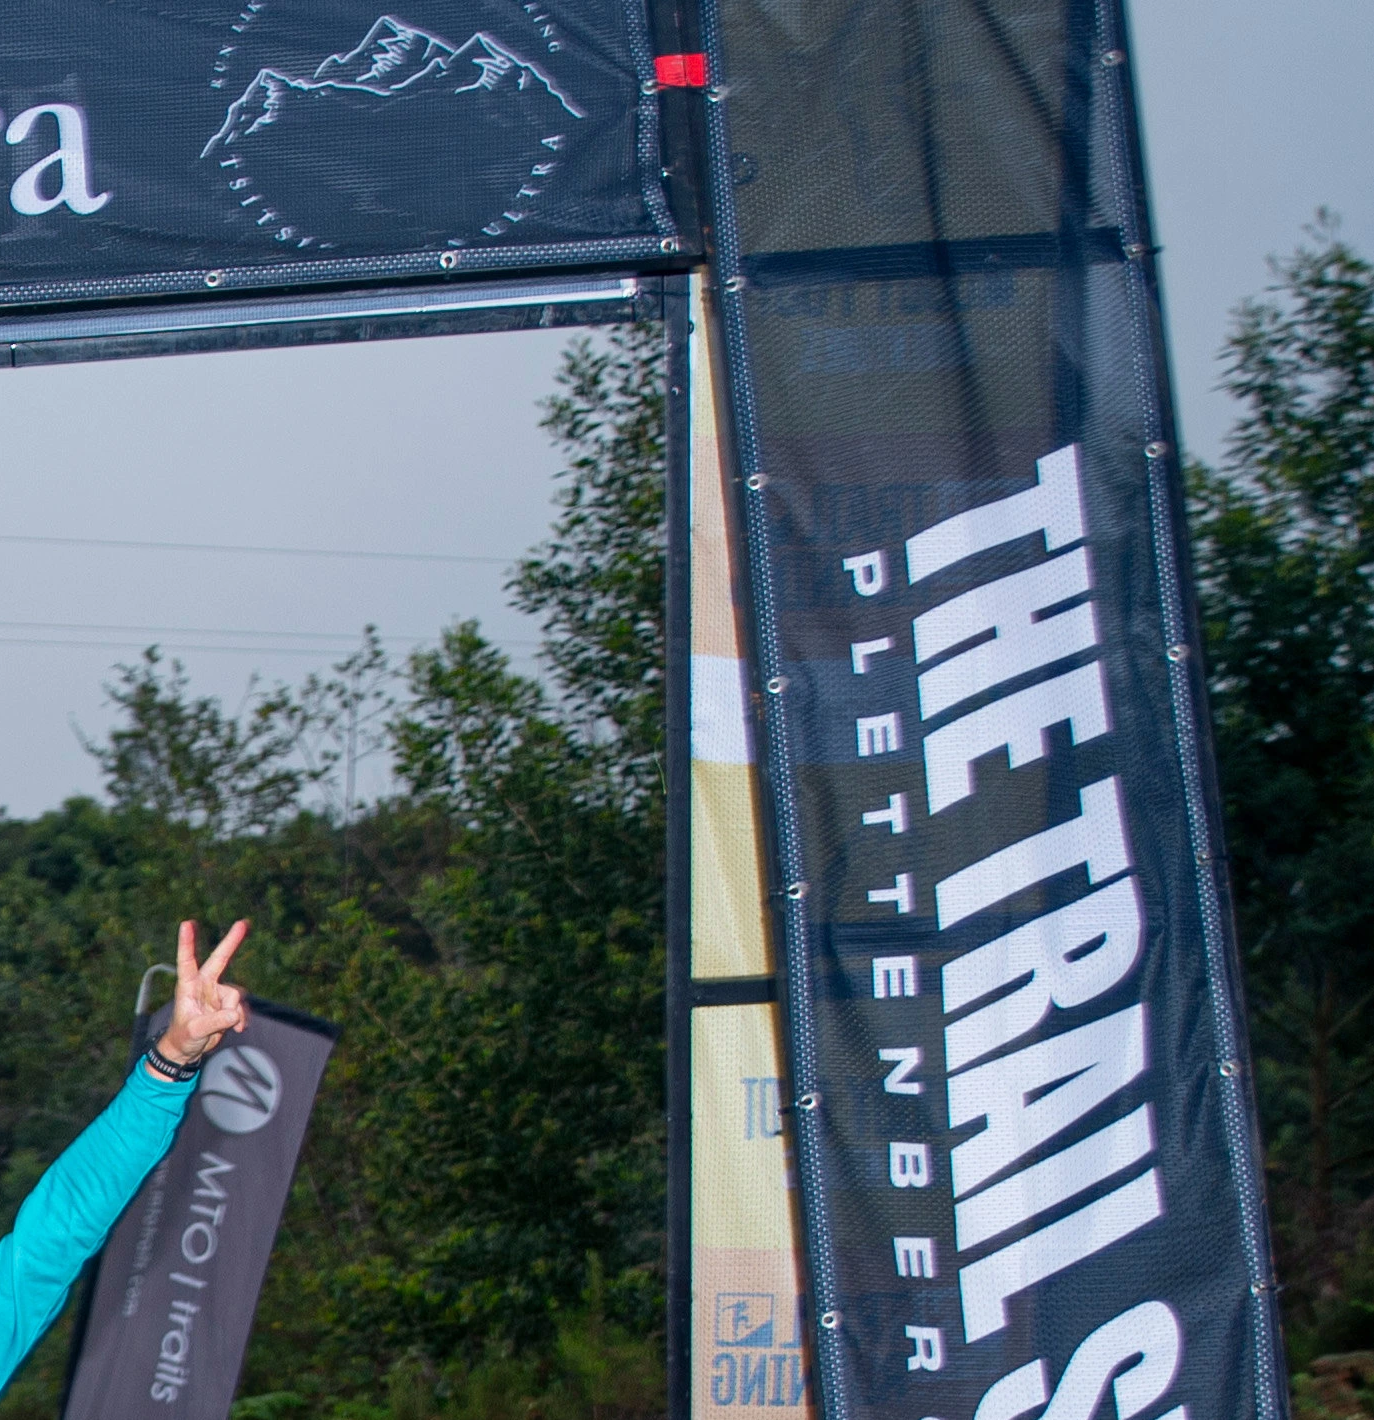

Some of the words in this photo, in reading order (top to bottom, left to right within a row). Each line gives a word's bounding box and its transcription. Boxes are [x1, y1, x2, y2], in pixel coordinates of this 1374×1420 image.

[231, 0, 265, 33] LIK
[481, 134, 566, 237] ULTRA
[905, 442, 1113, 816] THE
[935, 774, 1163, 1346] TRAIL
[181, 1152, 236, 1264] MTO
[151, 1300, 201, 1404] trails
